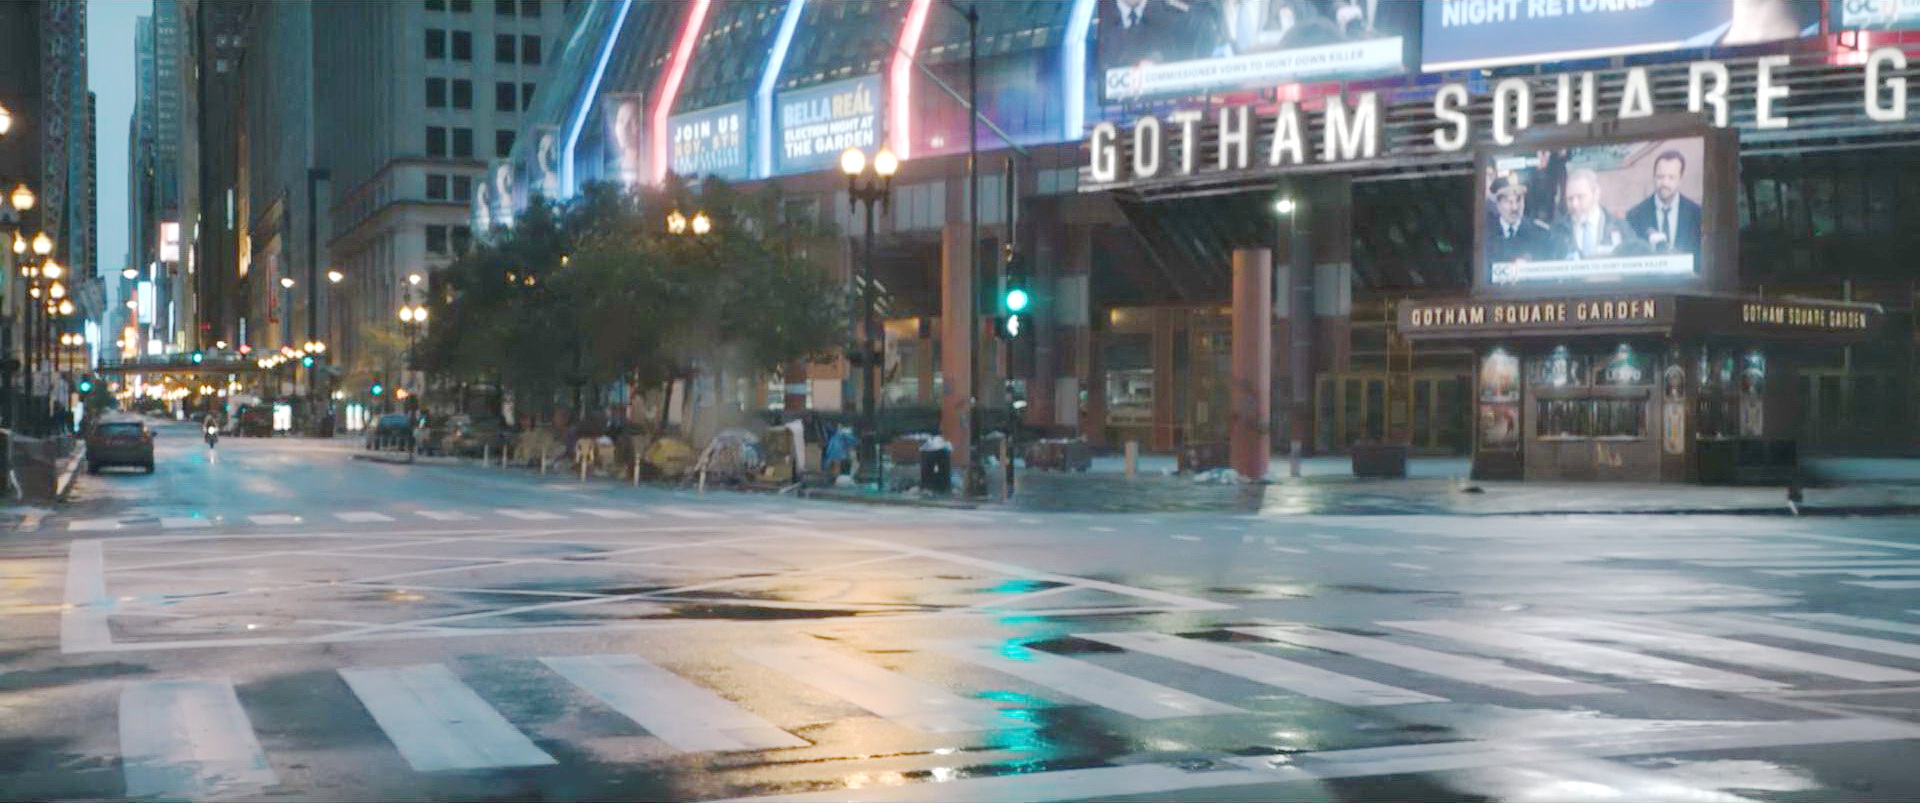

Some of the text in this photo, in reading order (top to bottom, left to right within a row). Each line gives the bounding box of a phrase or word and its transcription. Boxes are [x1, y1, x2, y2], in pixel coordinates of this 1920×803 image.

[1441, 0, 1519, 27] NIGHT
[1145, 66, 1217, 83] COMMISSIONER
[1220, 63, 1247, 75] VOWS
[1250, 61, 1262, 71] TO
[1265, 57, 1293, 69] HUNT
[1295, 54, 1326, 66] DOWN
[1329, 49, 1363, 62] KILLER
[674, 113, 739, 144] JOIN US
[784, 113, 874, 143] ELECTION NIGHT AT
[1090, 92, 1377, 182] GOTHAM
[1433, 55, 1790, 151] SQUARE
[674, 138, 706, 157] NOV.
[785, 129, 874, 159] THE GARDEN
[1411, 299, 1656, 326] GOTHAM SQUARE GARDEN
[1743, 303, 1867, 329] GOTHAM SQUARE GARDEN
